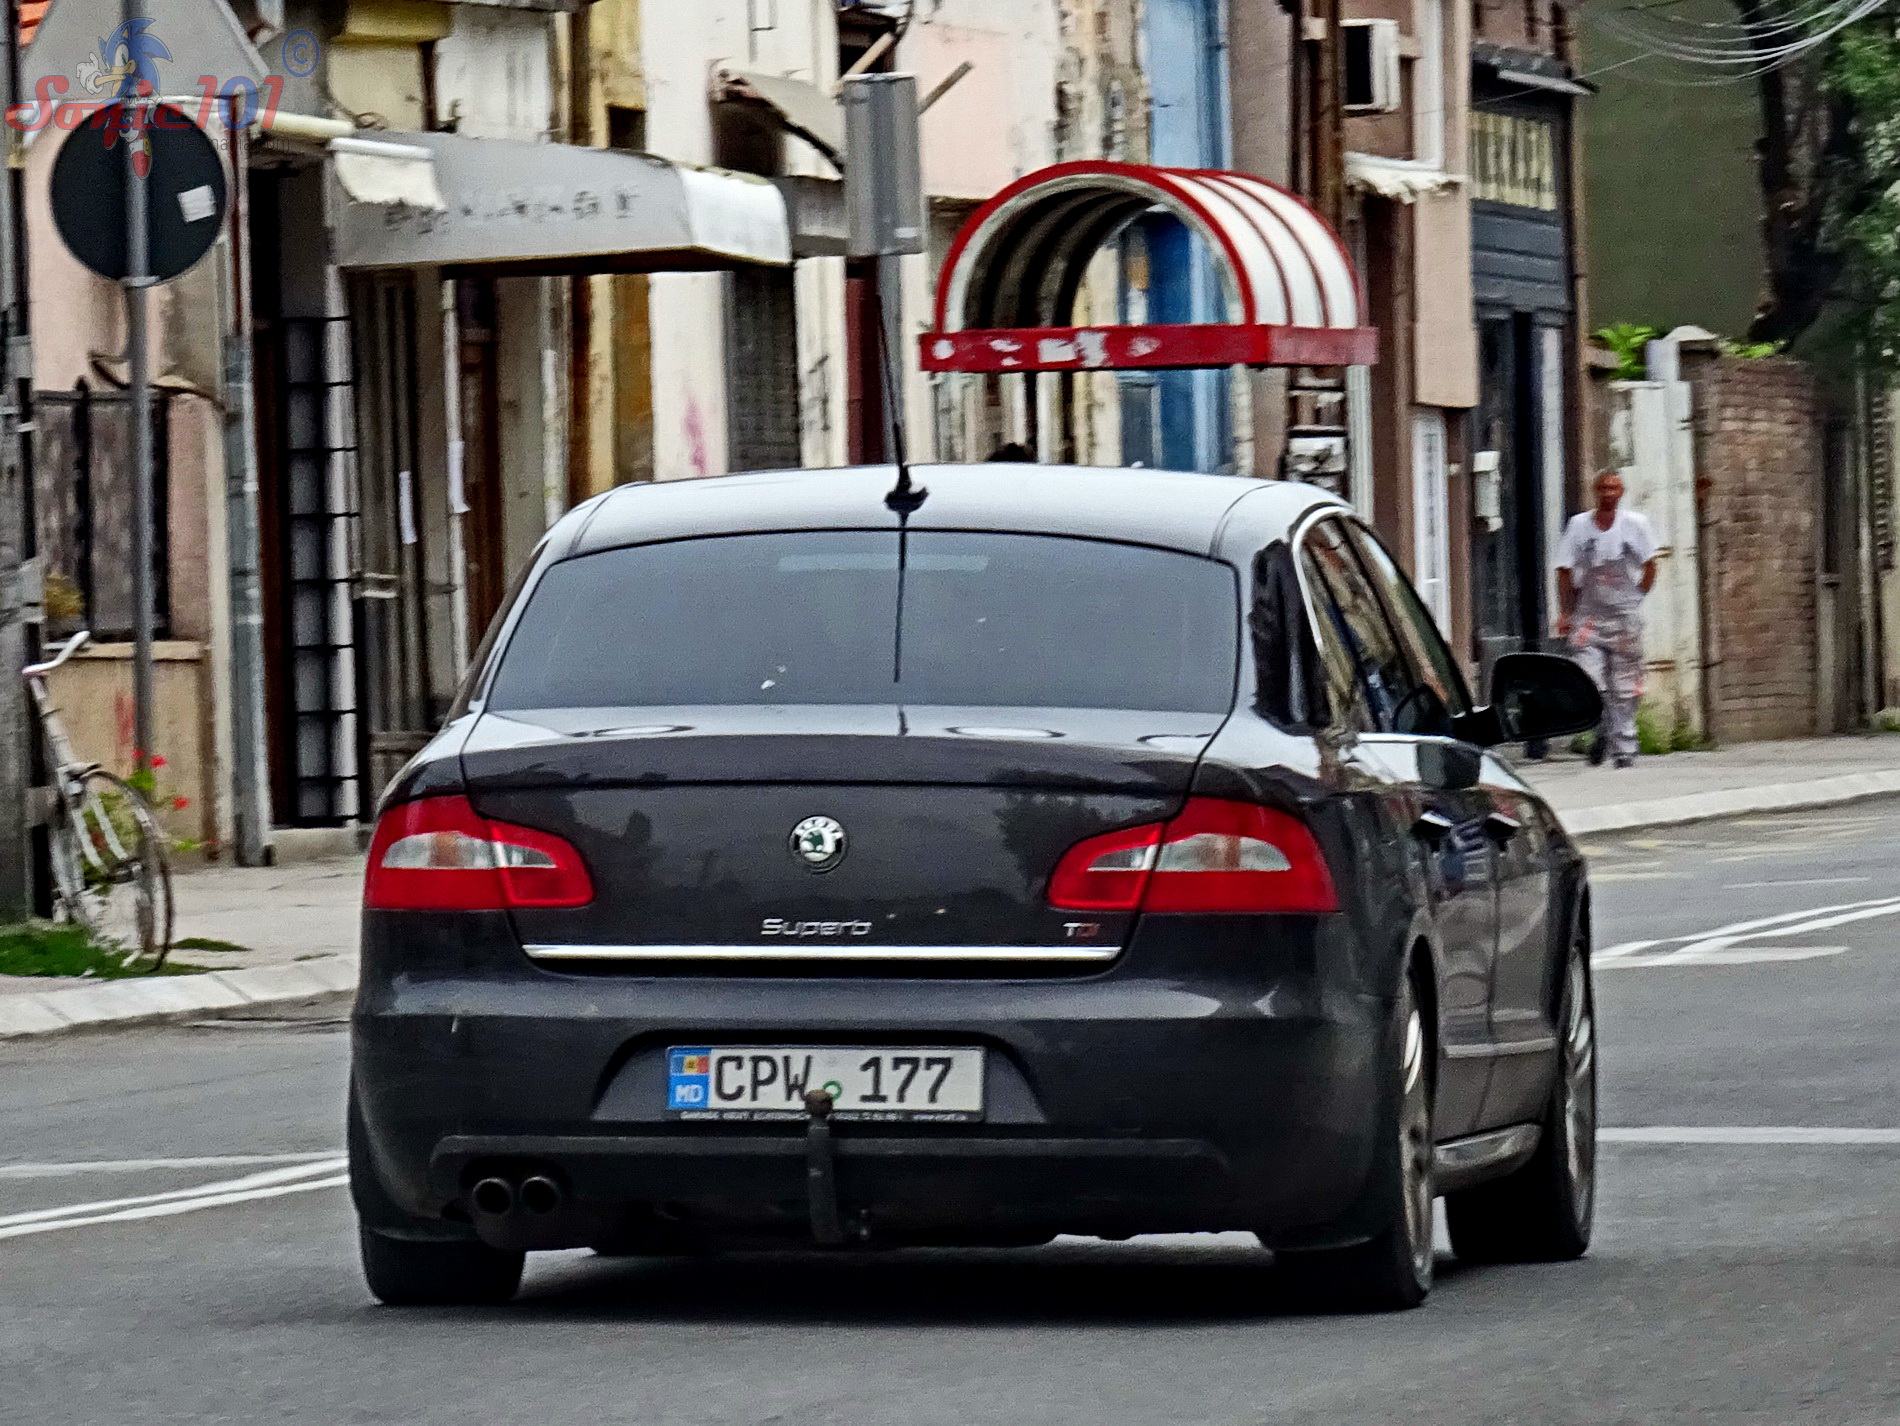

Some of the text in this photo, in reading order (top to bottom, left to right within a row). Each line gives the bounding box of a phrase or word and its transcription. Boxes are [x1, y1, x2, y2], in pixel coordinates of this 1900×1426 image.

[760, 918, 873, 938] Superb
[714, 1054, 954, 1104] CPW 177
[674, 1084, 704, 1103] MD
